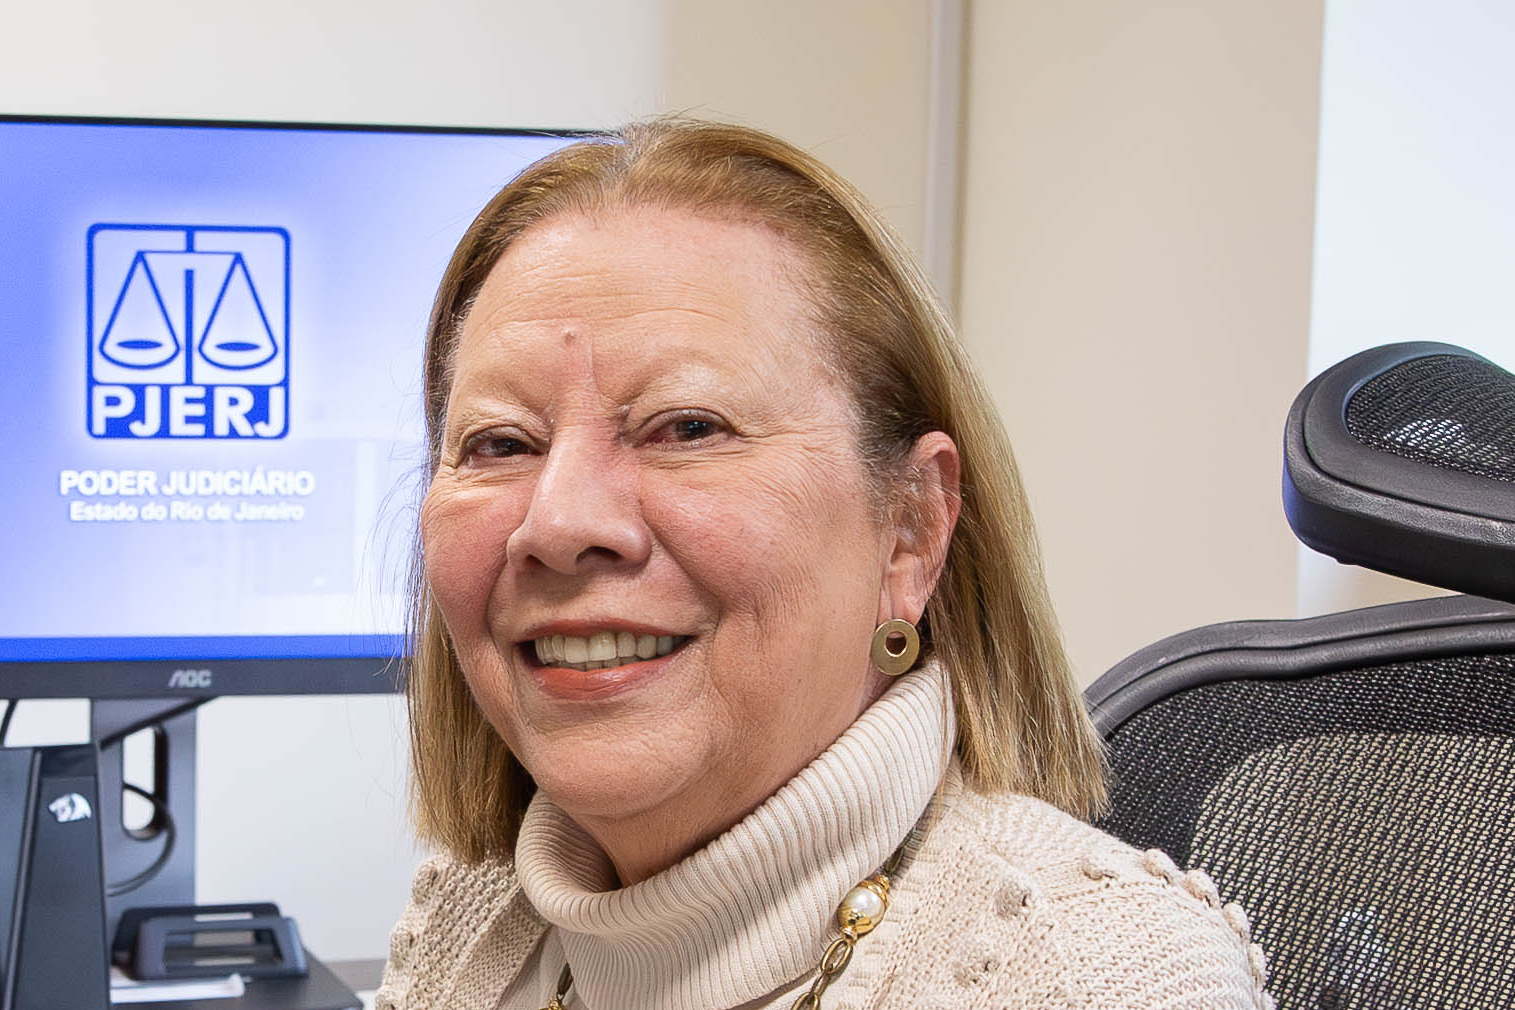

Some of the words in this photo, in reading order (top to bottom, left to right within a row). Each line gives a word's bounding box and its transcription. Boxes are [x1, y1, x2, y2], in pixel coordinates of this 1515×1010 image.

[91, 384, 286, 438] PJERJ
[59, 469, 159, 497] PODER
[162, 466, 314, 496] JUDICIÁRIO
[69, 500, 139, 523] Estado
[140, 500, 168, 522] do
[169, 500, 205, 522] Rio
[206, 500, 233, 521] de
[234, 500, 306, 522] Janeiro
[168, 669, 213, 689] AOC
